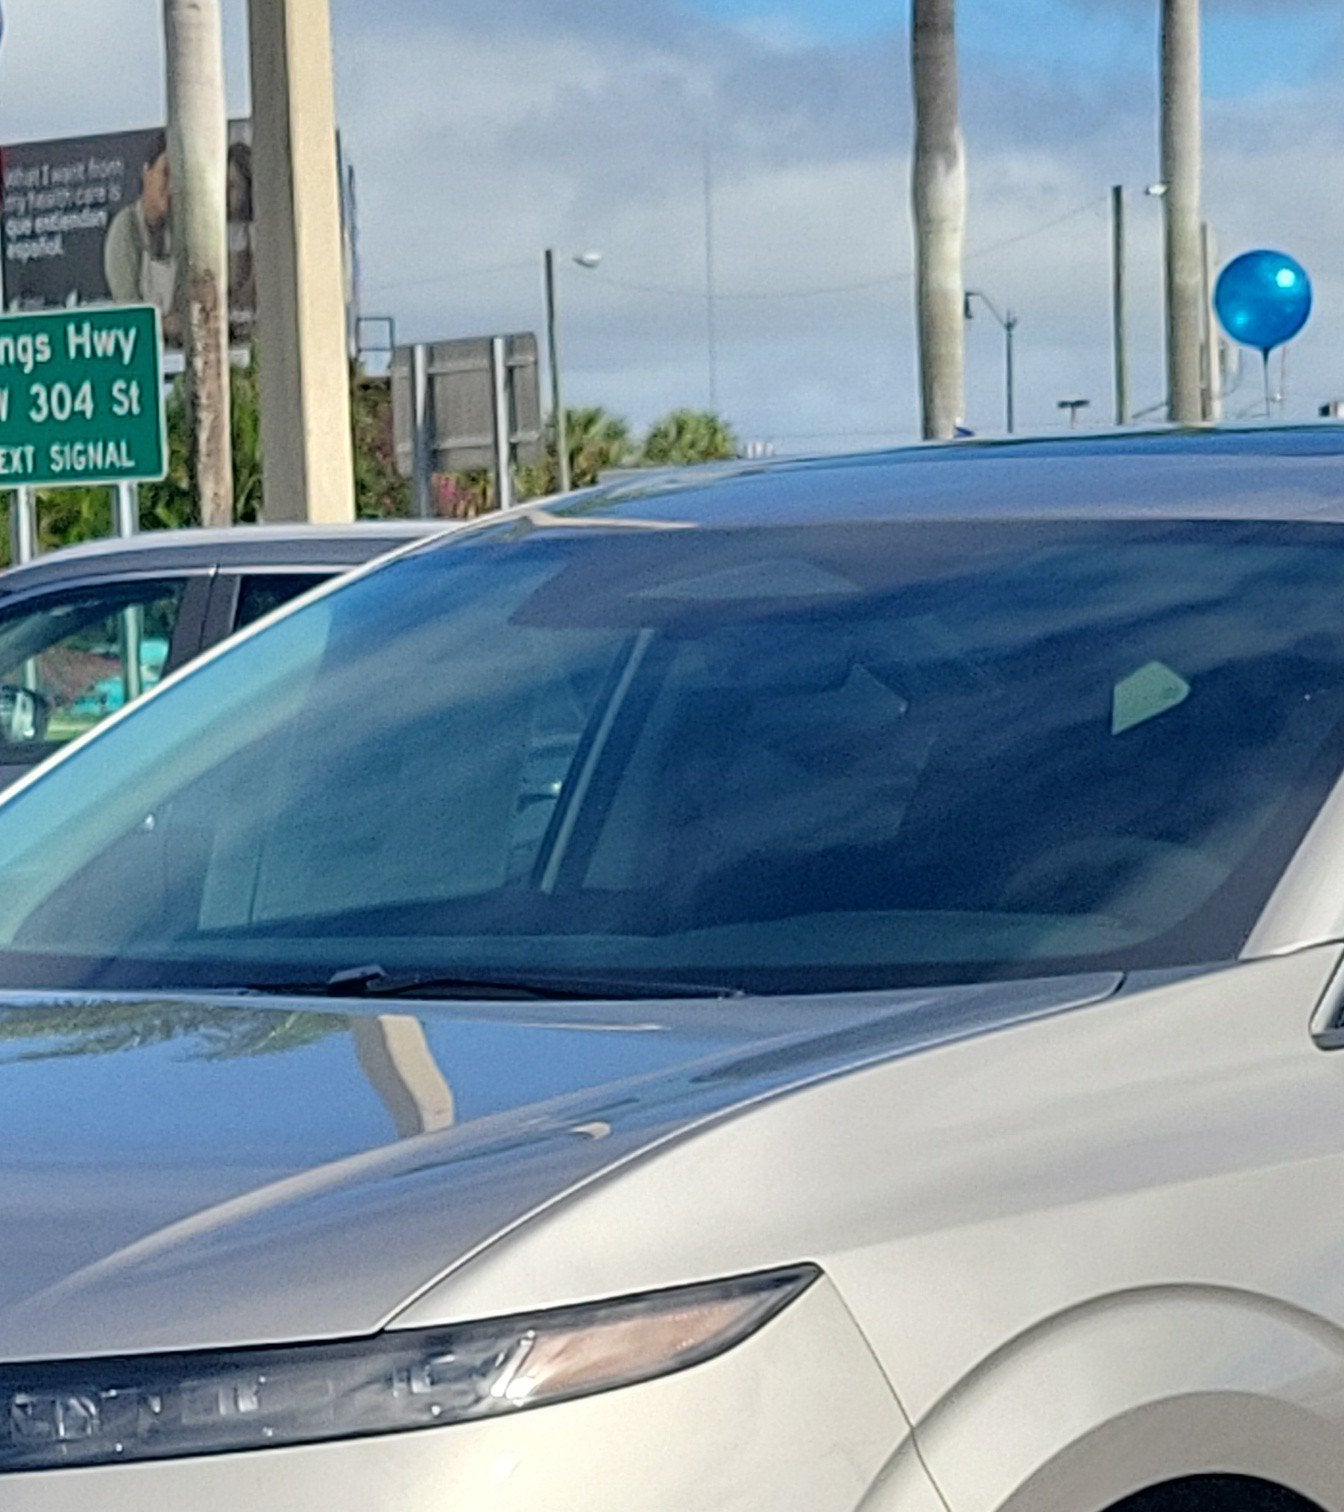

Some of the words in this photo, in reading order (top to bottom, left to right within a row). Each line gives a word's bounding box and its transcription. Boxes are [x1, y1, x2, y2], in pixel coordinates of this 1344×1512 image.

[67, 321, 137, 366] Hwy
[29, 380, 94, 423] 304
[112, 379, 141, 417] St
[50, 439, 136, 472] SIGNAL
